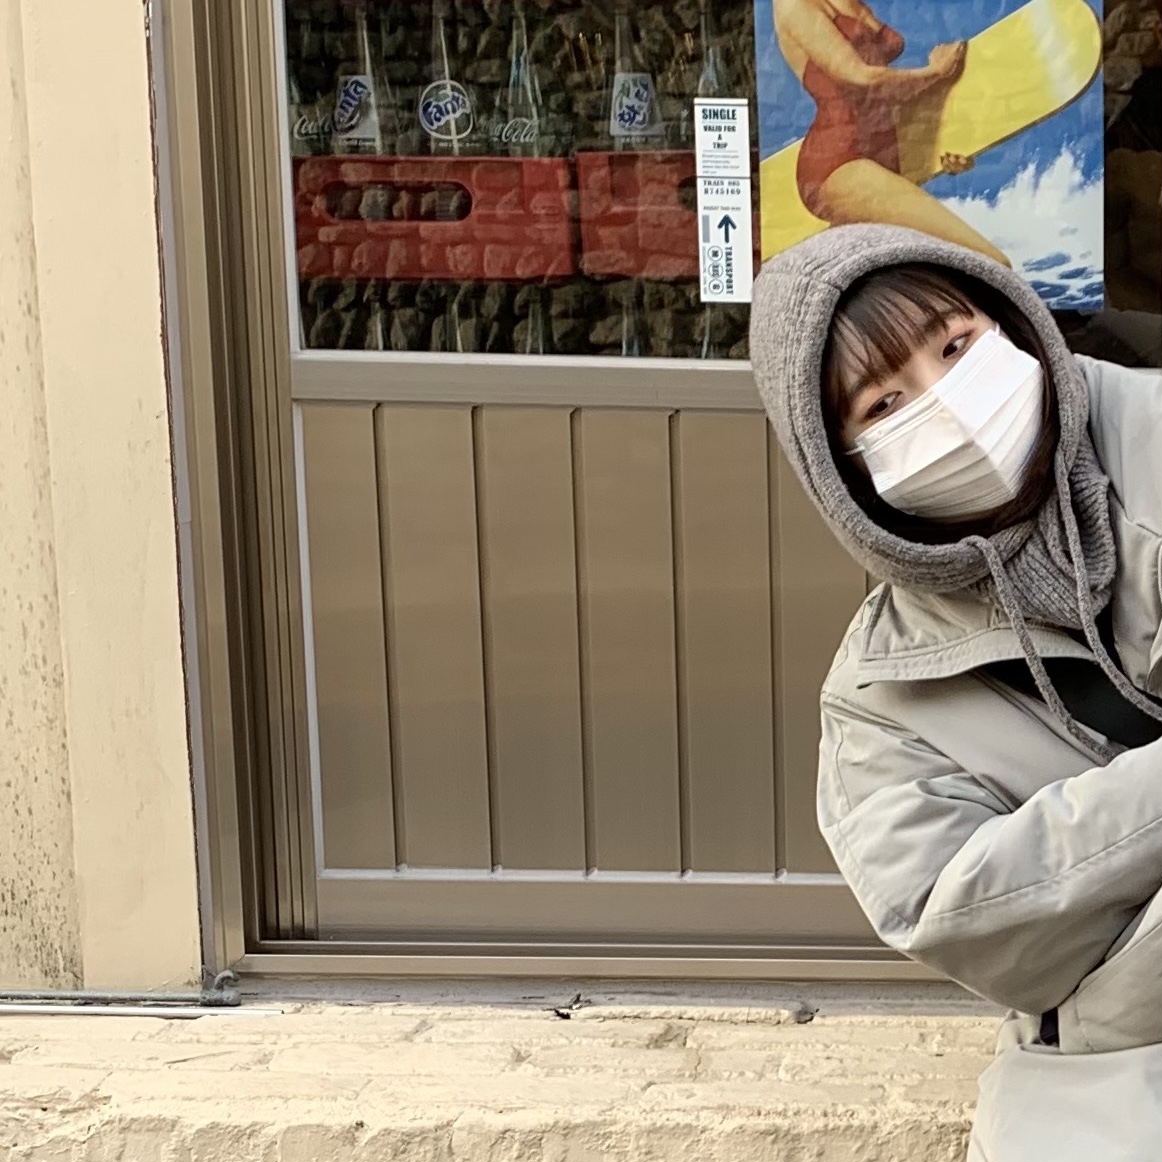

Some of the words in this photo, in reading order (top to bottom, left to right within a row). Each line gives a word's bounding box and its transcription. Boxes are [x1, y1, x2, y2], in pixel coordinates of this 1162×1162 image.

[422, 91, 471, 130] Fanta
[702, 108, 737, 120] SINGLE
[725, 246, 734, 295] TRANSPORT
